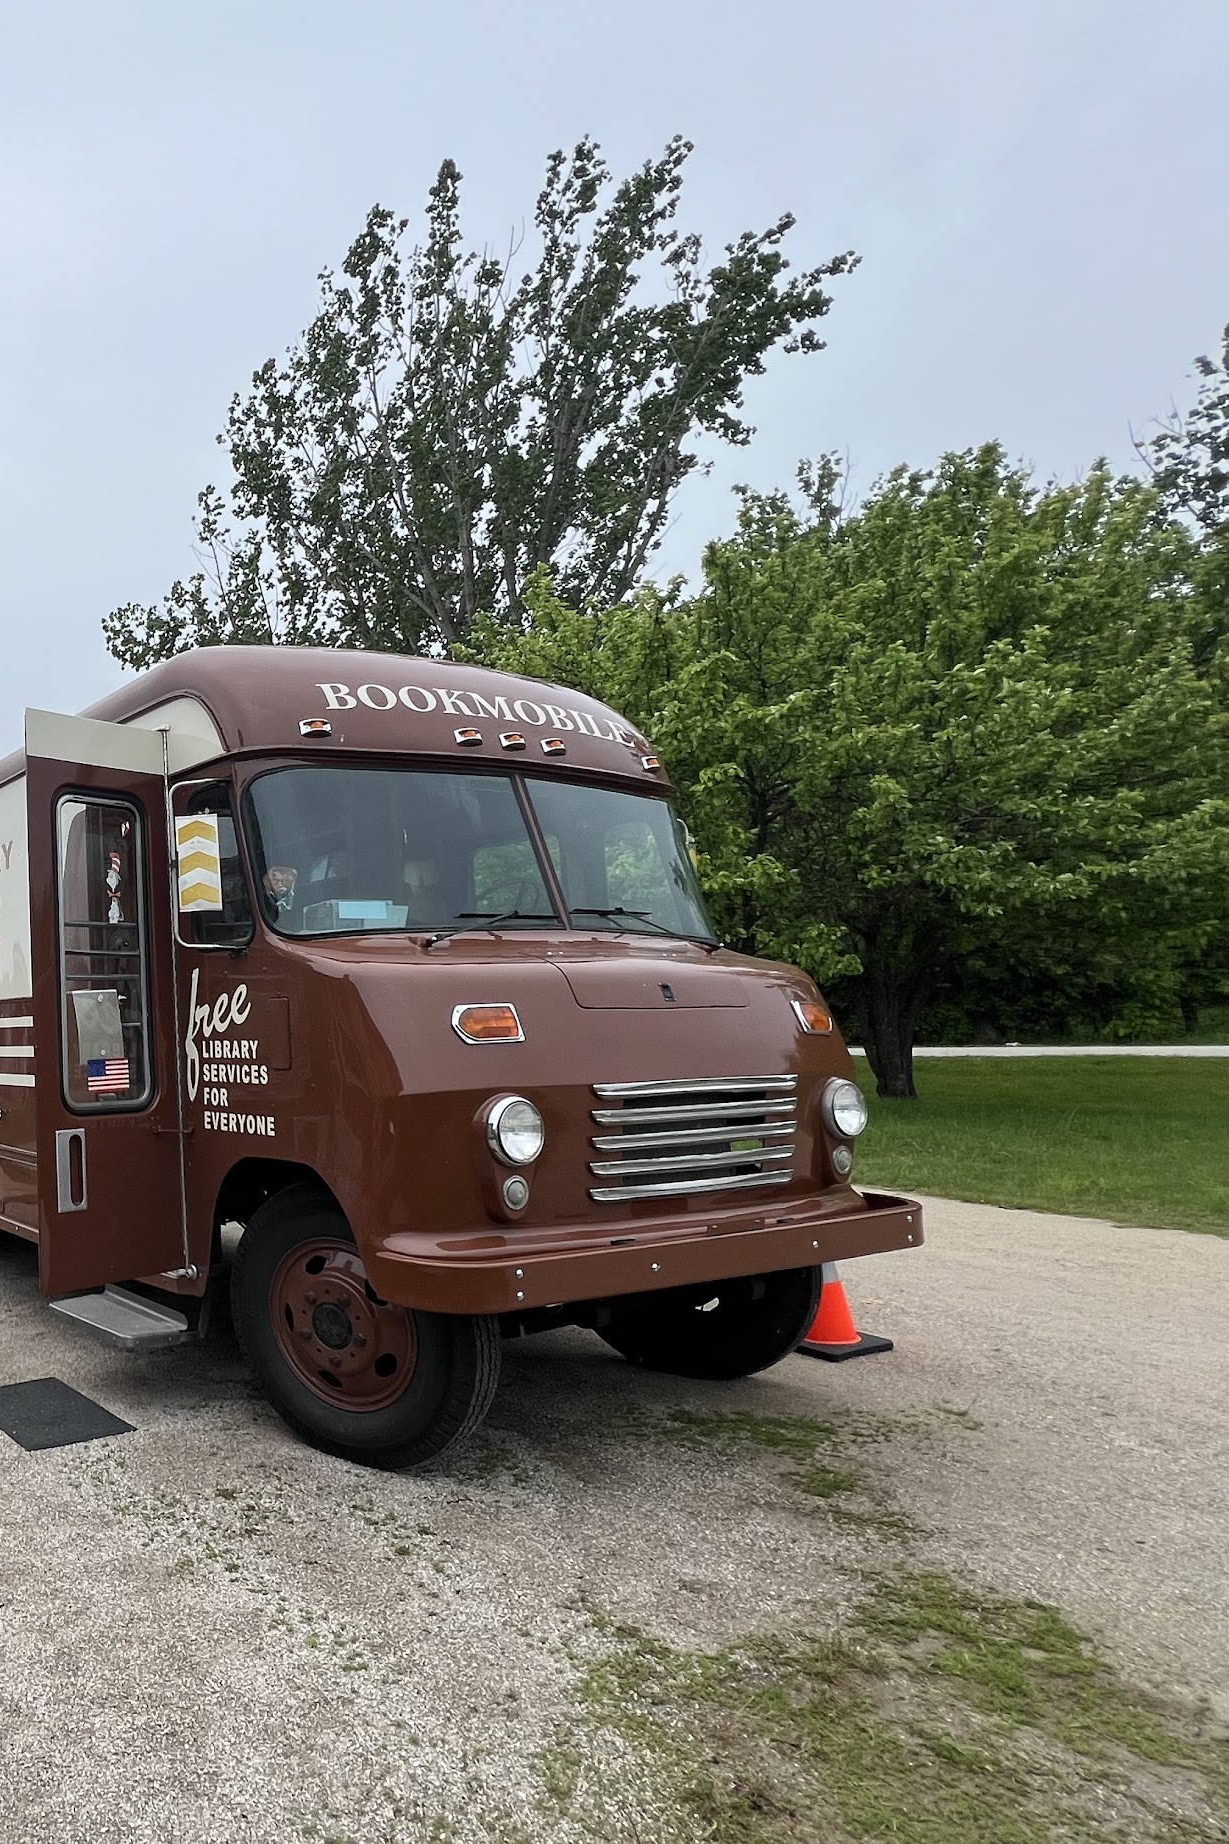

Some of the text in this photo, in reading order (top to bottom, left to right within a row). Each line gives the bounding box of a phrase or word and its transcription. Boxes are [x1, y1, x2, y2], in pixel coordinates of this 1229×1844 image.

[315, 682, 635, 748] BOOKMOBILE
[202, 1040, 258, 1060] LIBRARY
[202, 1063, 269, 1085] SERVICES
[203, 1087, 229, 1107] FOR
[204, 1110, 276, 1137] EVERYONE
